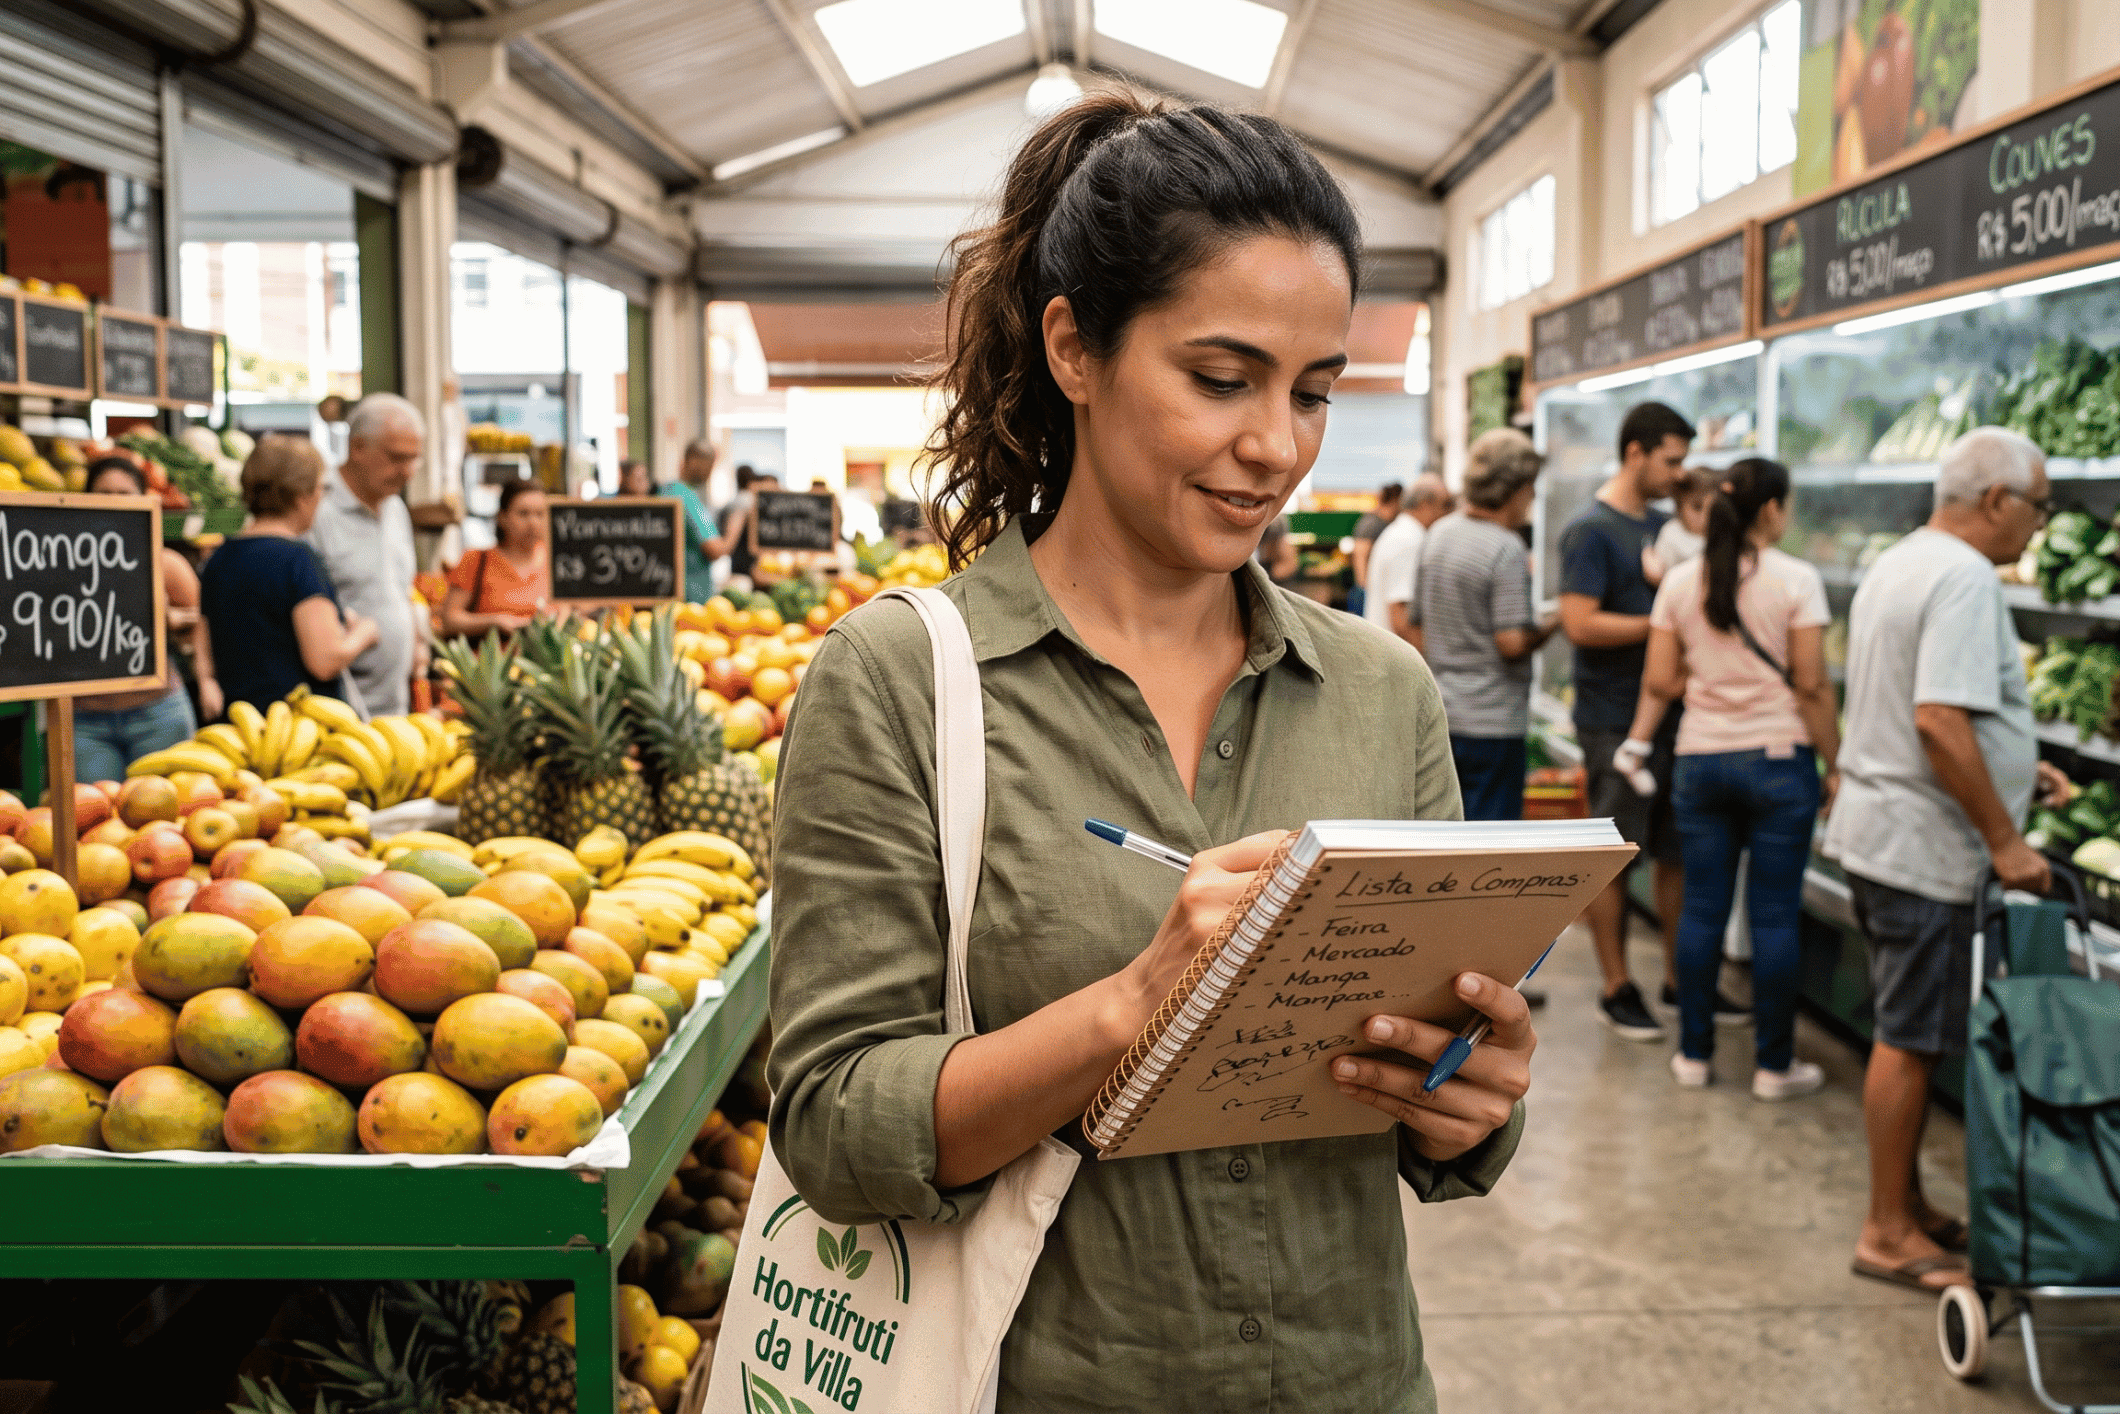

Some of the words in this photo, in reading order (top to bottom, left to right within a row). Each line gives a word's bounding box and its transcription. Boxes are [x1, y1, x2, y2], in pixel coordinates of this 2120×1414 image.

[1989, 112, 2096, 194] COUVES
[1977, 209, 2008, 261] R$
[13, 591, 150, 675] 9,90/kg
[1336, 871, 1413, 898] Lista
[1426, 872, 1458, 893] de
[1470, 867, 1590, 898] Compras:
[1302, 938, 1415, 962] Mercado
[1321, 916, 1389, 937] Feira
[1283, 970, 1370, 992] Manga
[753, 1255, 898, 1365] Hortifruti
[755, 1318, 792, 1371] da
[804, 1338, 863, 1412] Villa
